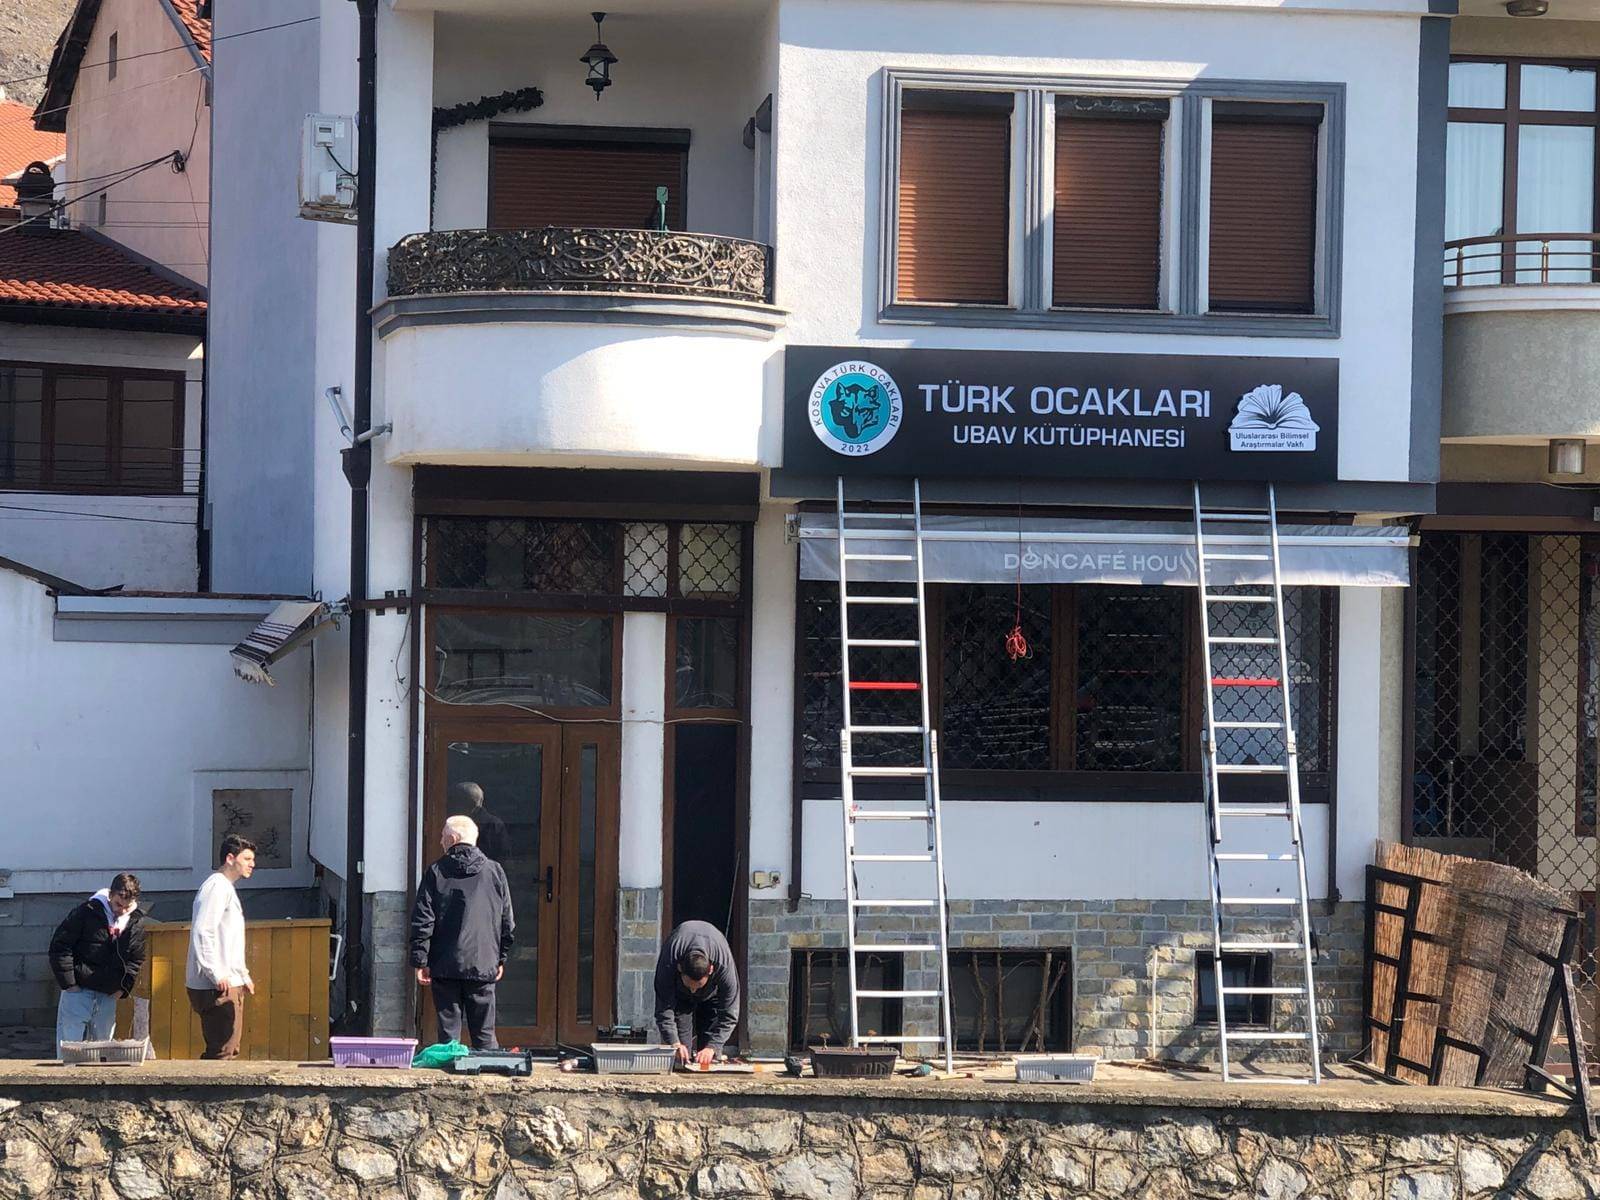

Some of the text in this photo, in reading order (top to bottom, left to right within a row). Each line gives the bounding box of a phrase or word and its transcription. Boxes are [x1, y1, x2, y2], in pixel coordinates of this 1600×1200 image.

[812, 376, 832, 426] KOSOVA
[870, 368, 900, 427] OCAKLARI
[918, 380, 1211, 418] TÜRK OCAKLARI
[953, 423, 1185, 448] UBAV KÜTÜPHANESİ
[1235, 432, 1309, 440] Uluslararası Bilimsel
[1240, 441, 1304, 449] Araştırmalar Vakfı
[841, 443, 870, 453] 2022
[1004, 547, 1127, 570] DONCAFÉ
